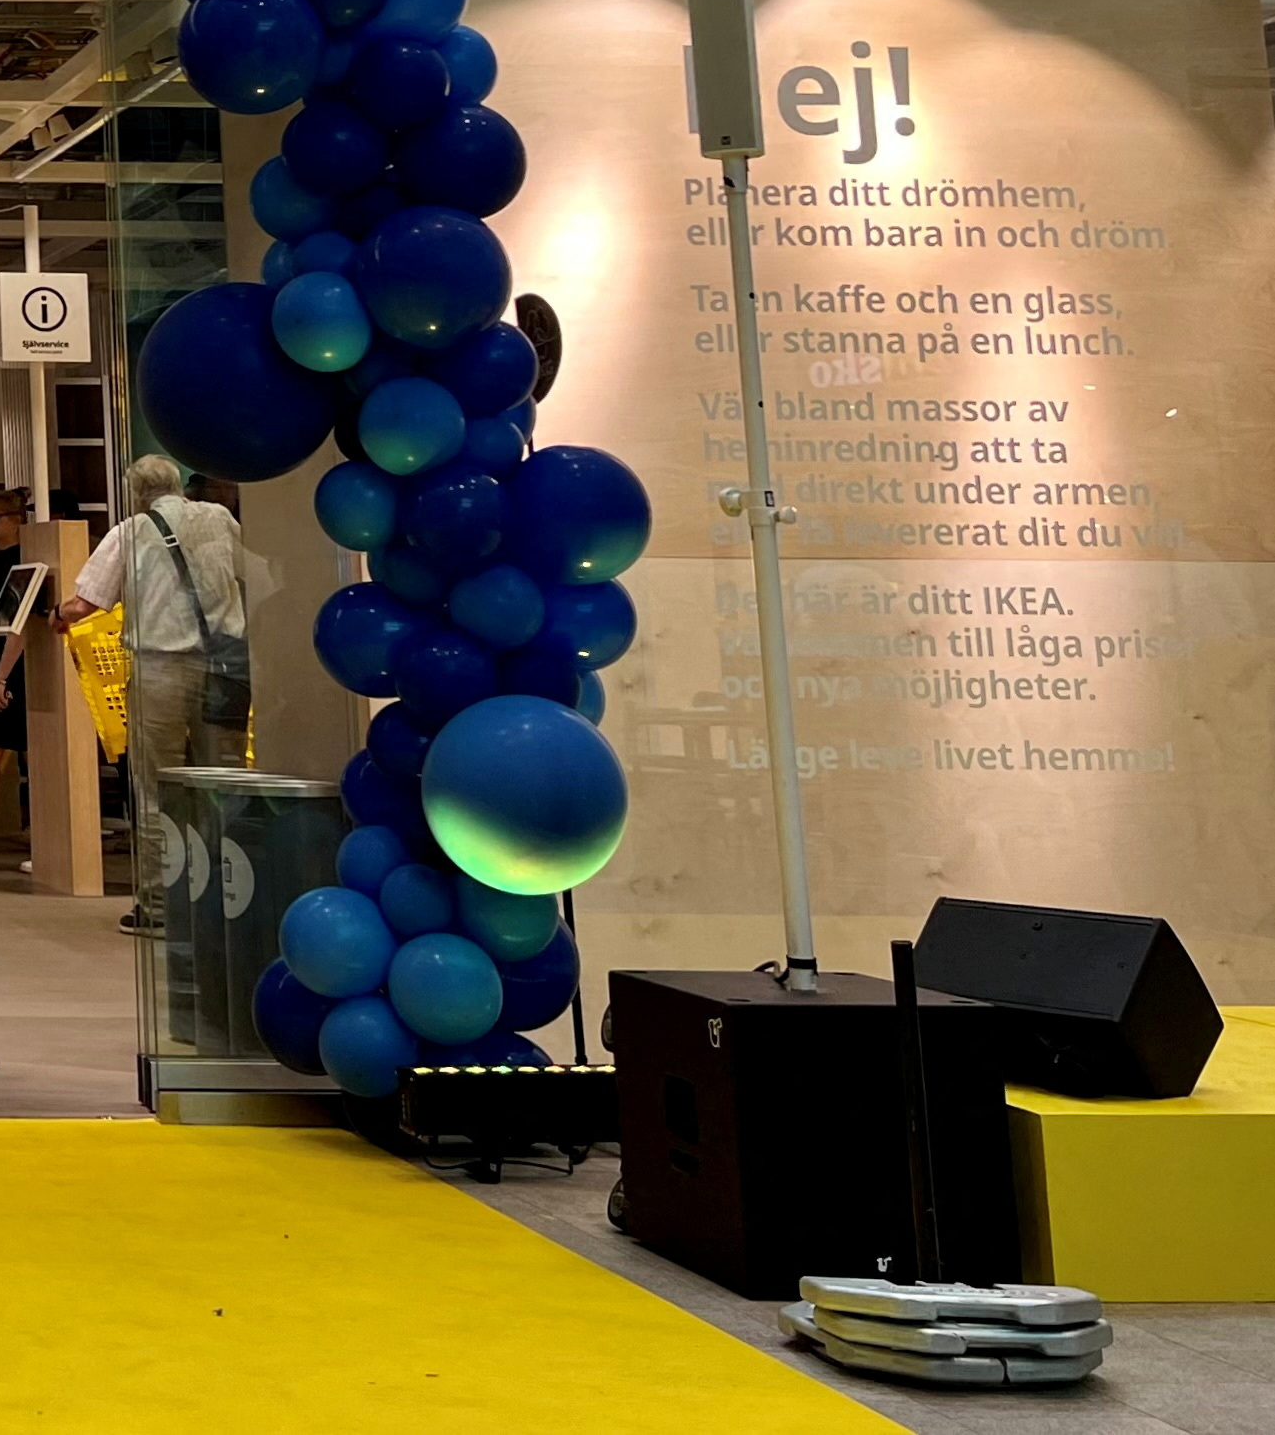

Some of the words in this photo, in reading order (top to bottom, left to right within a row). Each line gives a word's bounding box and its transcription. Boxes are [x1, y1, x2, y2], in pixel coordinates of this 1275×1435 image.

[683, 41, 916, 165] ej!
[829, 180, 891, 208] ditt
[902, 180, 1087, 213] drömhem,
[686, 218, 764, 247] ellr
[776, 218, 853, 247] kom
[865, 219, 943, 247] bara
[955, 220, 987, 248] in
[997, 221, 1060, 248] och
[690, 284, 728, 313] Ta
[794, 285, 886, 314] kaffe
[896, 286, 959, 314] och
[969, 295, 1013, 314] en
[1024, 286, 1123, 322] glass,
[694, 324, 772, 354] ellr
[783, 326, 906, 354] stanna
[918, 323, 960, 362] på
[970, 335, 1014, 355] en
[1025, 326, 1135, 356] lunch.
[776, 391, 875, 421] bland
[887, 397, 1017, 422] massor
[1028, 399, 1070, 422] av
[970, 437, 1022, 463] att
[1031, 438, 1068, 463] ta
[796, 475, 904, 504] direkt
[914, 475, 1021, 506] under
[1018, 517, 1067, 547] dit
[1077, 517, 1122, 548] du
[861, 585, 898, 615] är
[908, 585, 974, 615] ditt
[983, 587, 1074, 617] IKEA.
[947, 628, 994, 658] till
[1006, 624, 1083, 667] låga
[797, 677, 862, 709] nya
[728, 739, 839, 777] Läge
[934, 740, 1014, 771] livet
